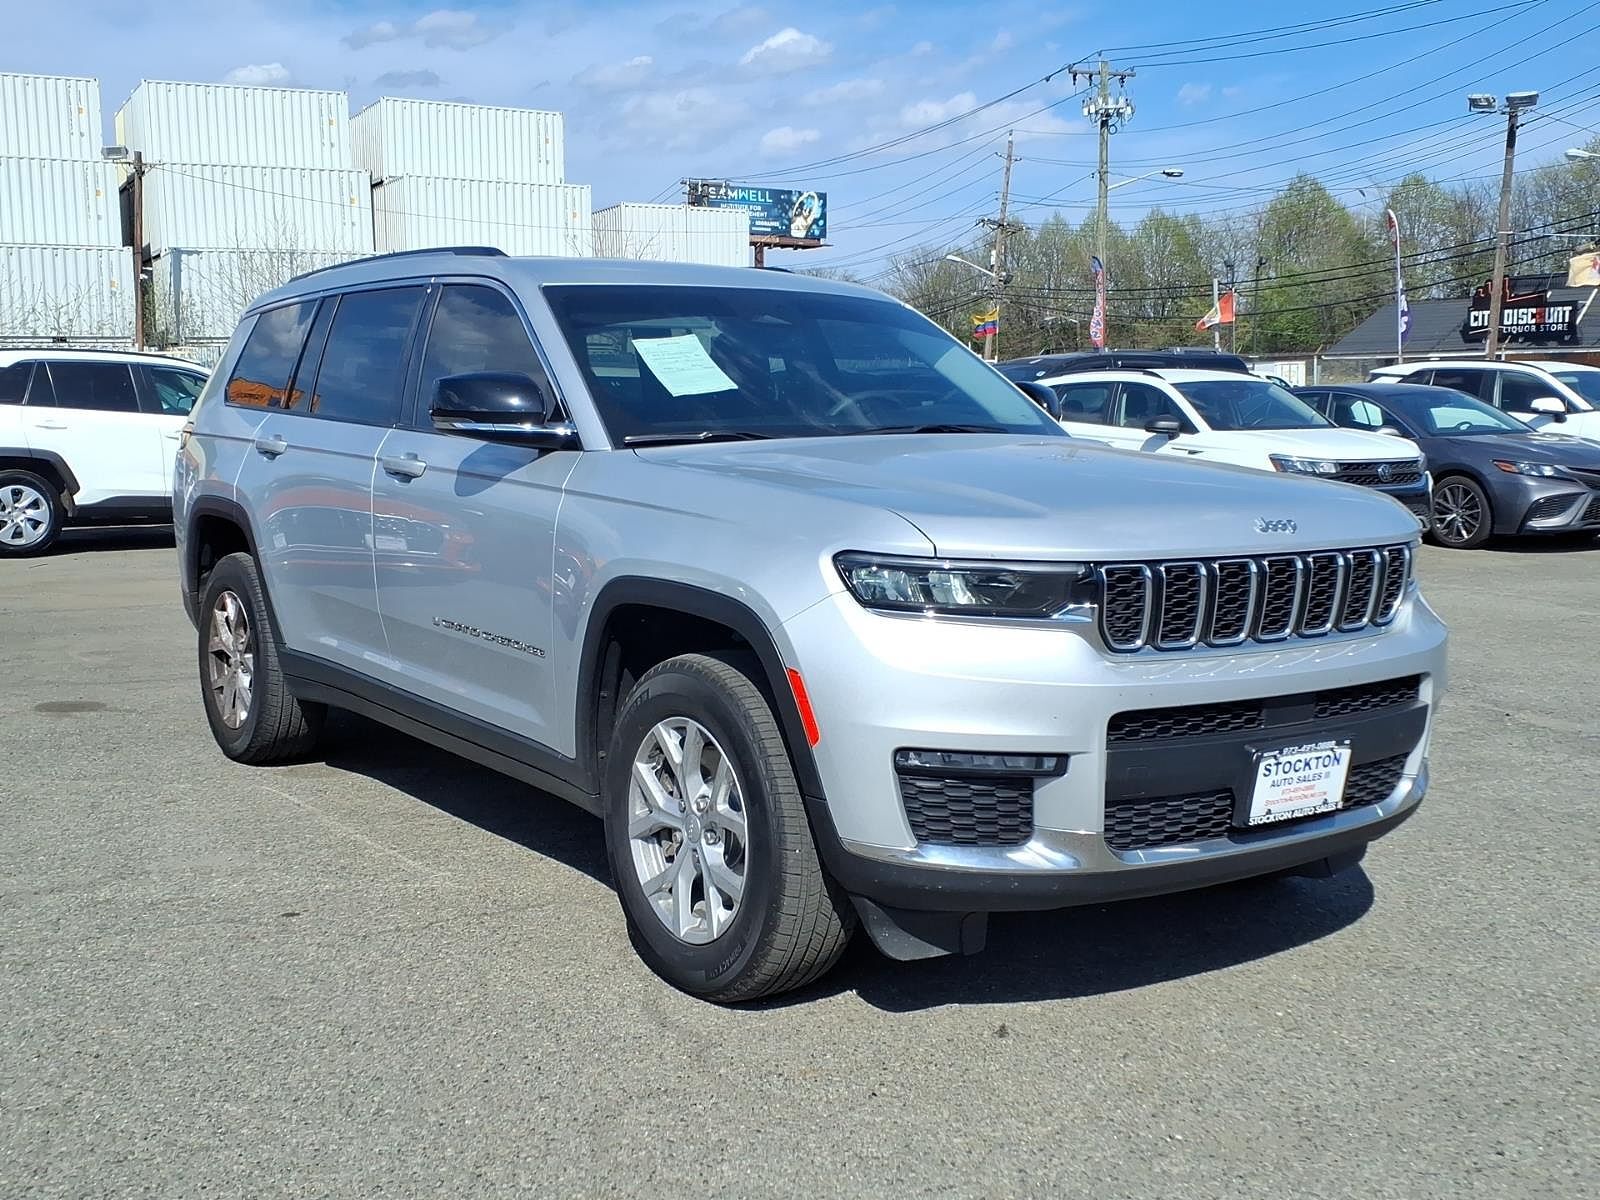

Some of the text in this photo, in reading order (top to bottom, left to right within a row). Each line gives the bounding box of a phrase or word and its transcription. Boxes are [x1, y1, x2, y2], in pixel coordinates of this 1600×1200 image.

[708, 187, 773, 203] SAMWELL
[1470, 310, 1491, 327] CIT
[1503, 323, 1569, 334] LIQUOR STORE
[1253, 517, 1298, 535] Jeep
[1262, 752, 1342, 778] STOCKTON
[1270, 777, 1294, 788] AUTO
[1295, 771, 1323, 785] SALES
[1248, 810, 1293, 826] STOCKTON
[1293, 806, 1315, 819] AUTO
